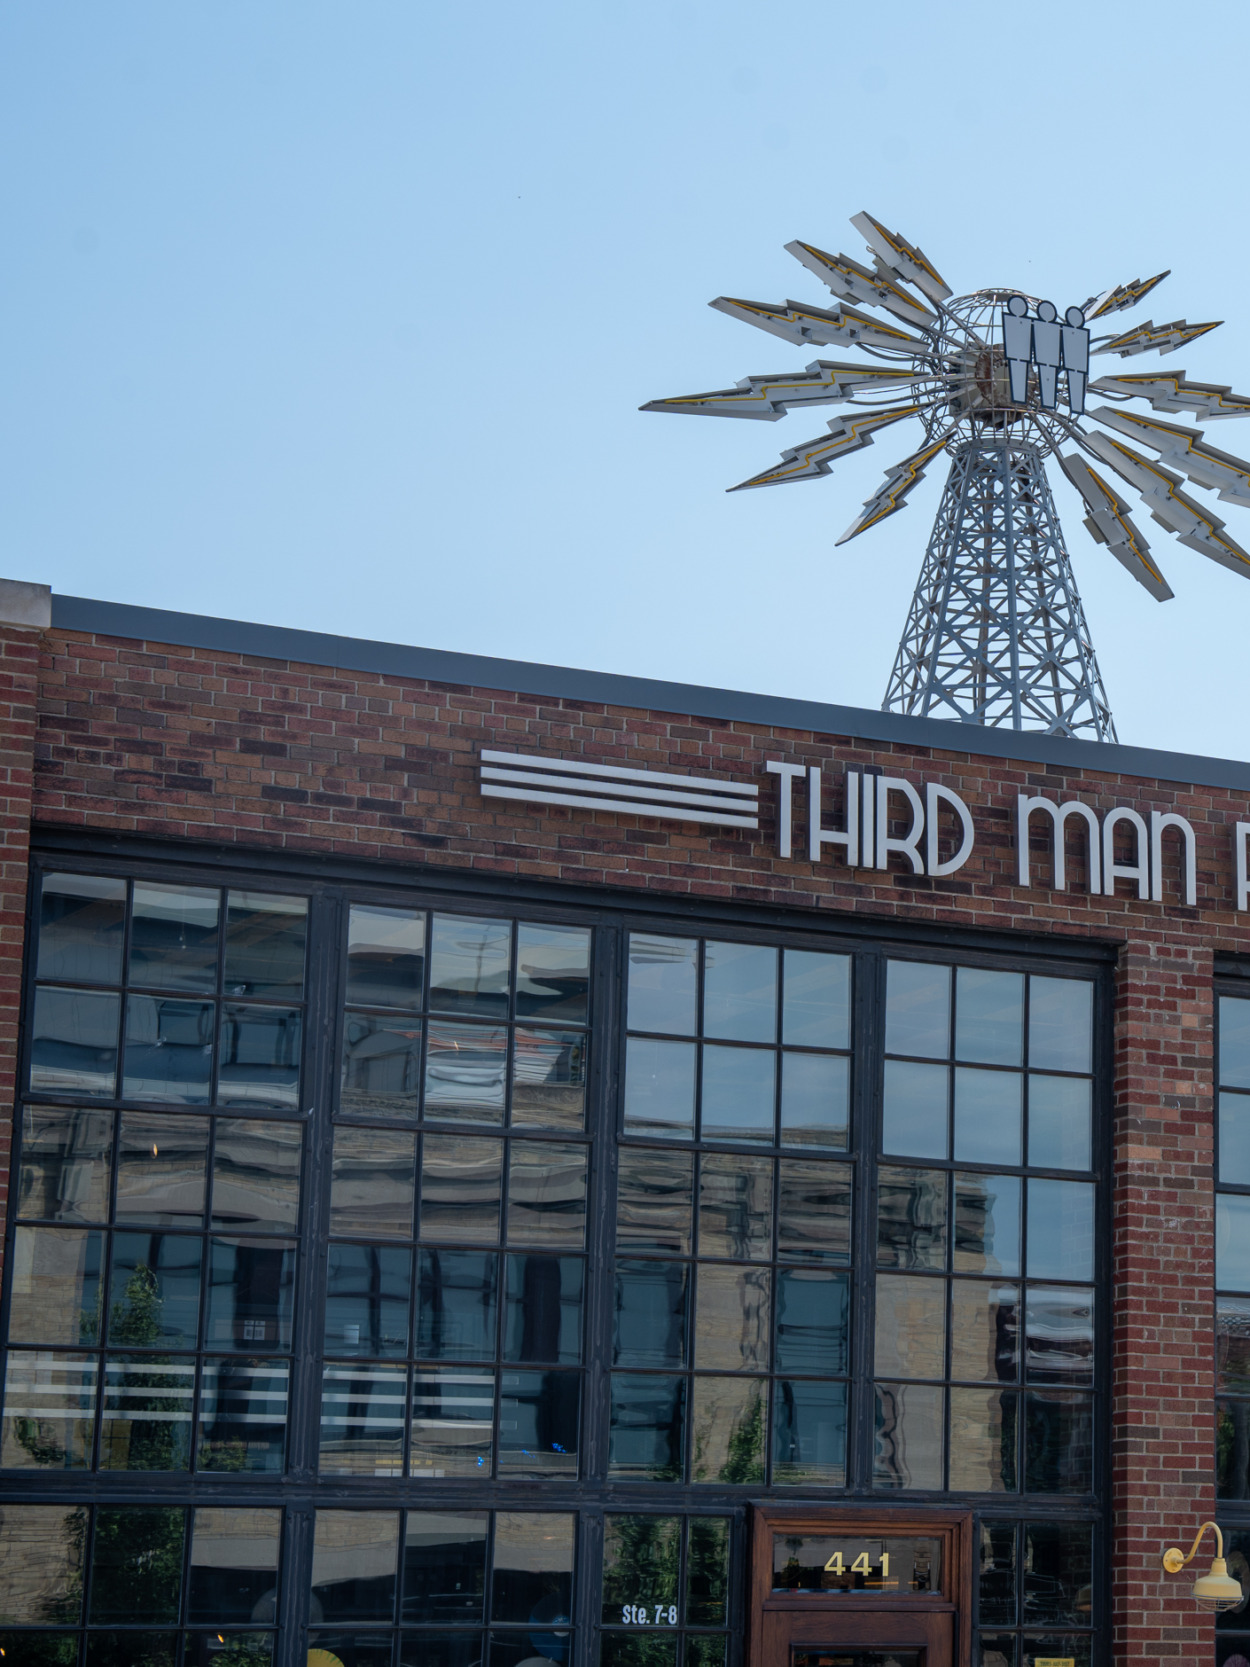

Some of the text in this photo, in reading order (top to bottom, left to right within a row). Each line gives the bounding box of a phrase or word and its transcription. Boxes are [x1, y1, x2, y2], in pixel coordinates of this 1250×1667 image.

[765, 759, 974, 876] THIRD
[1018, 794, 1197, 906] MAN
[824, 1551, 890, 1577] 441
[622, 1604, 678, 1625] Ste. 7-8
